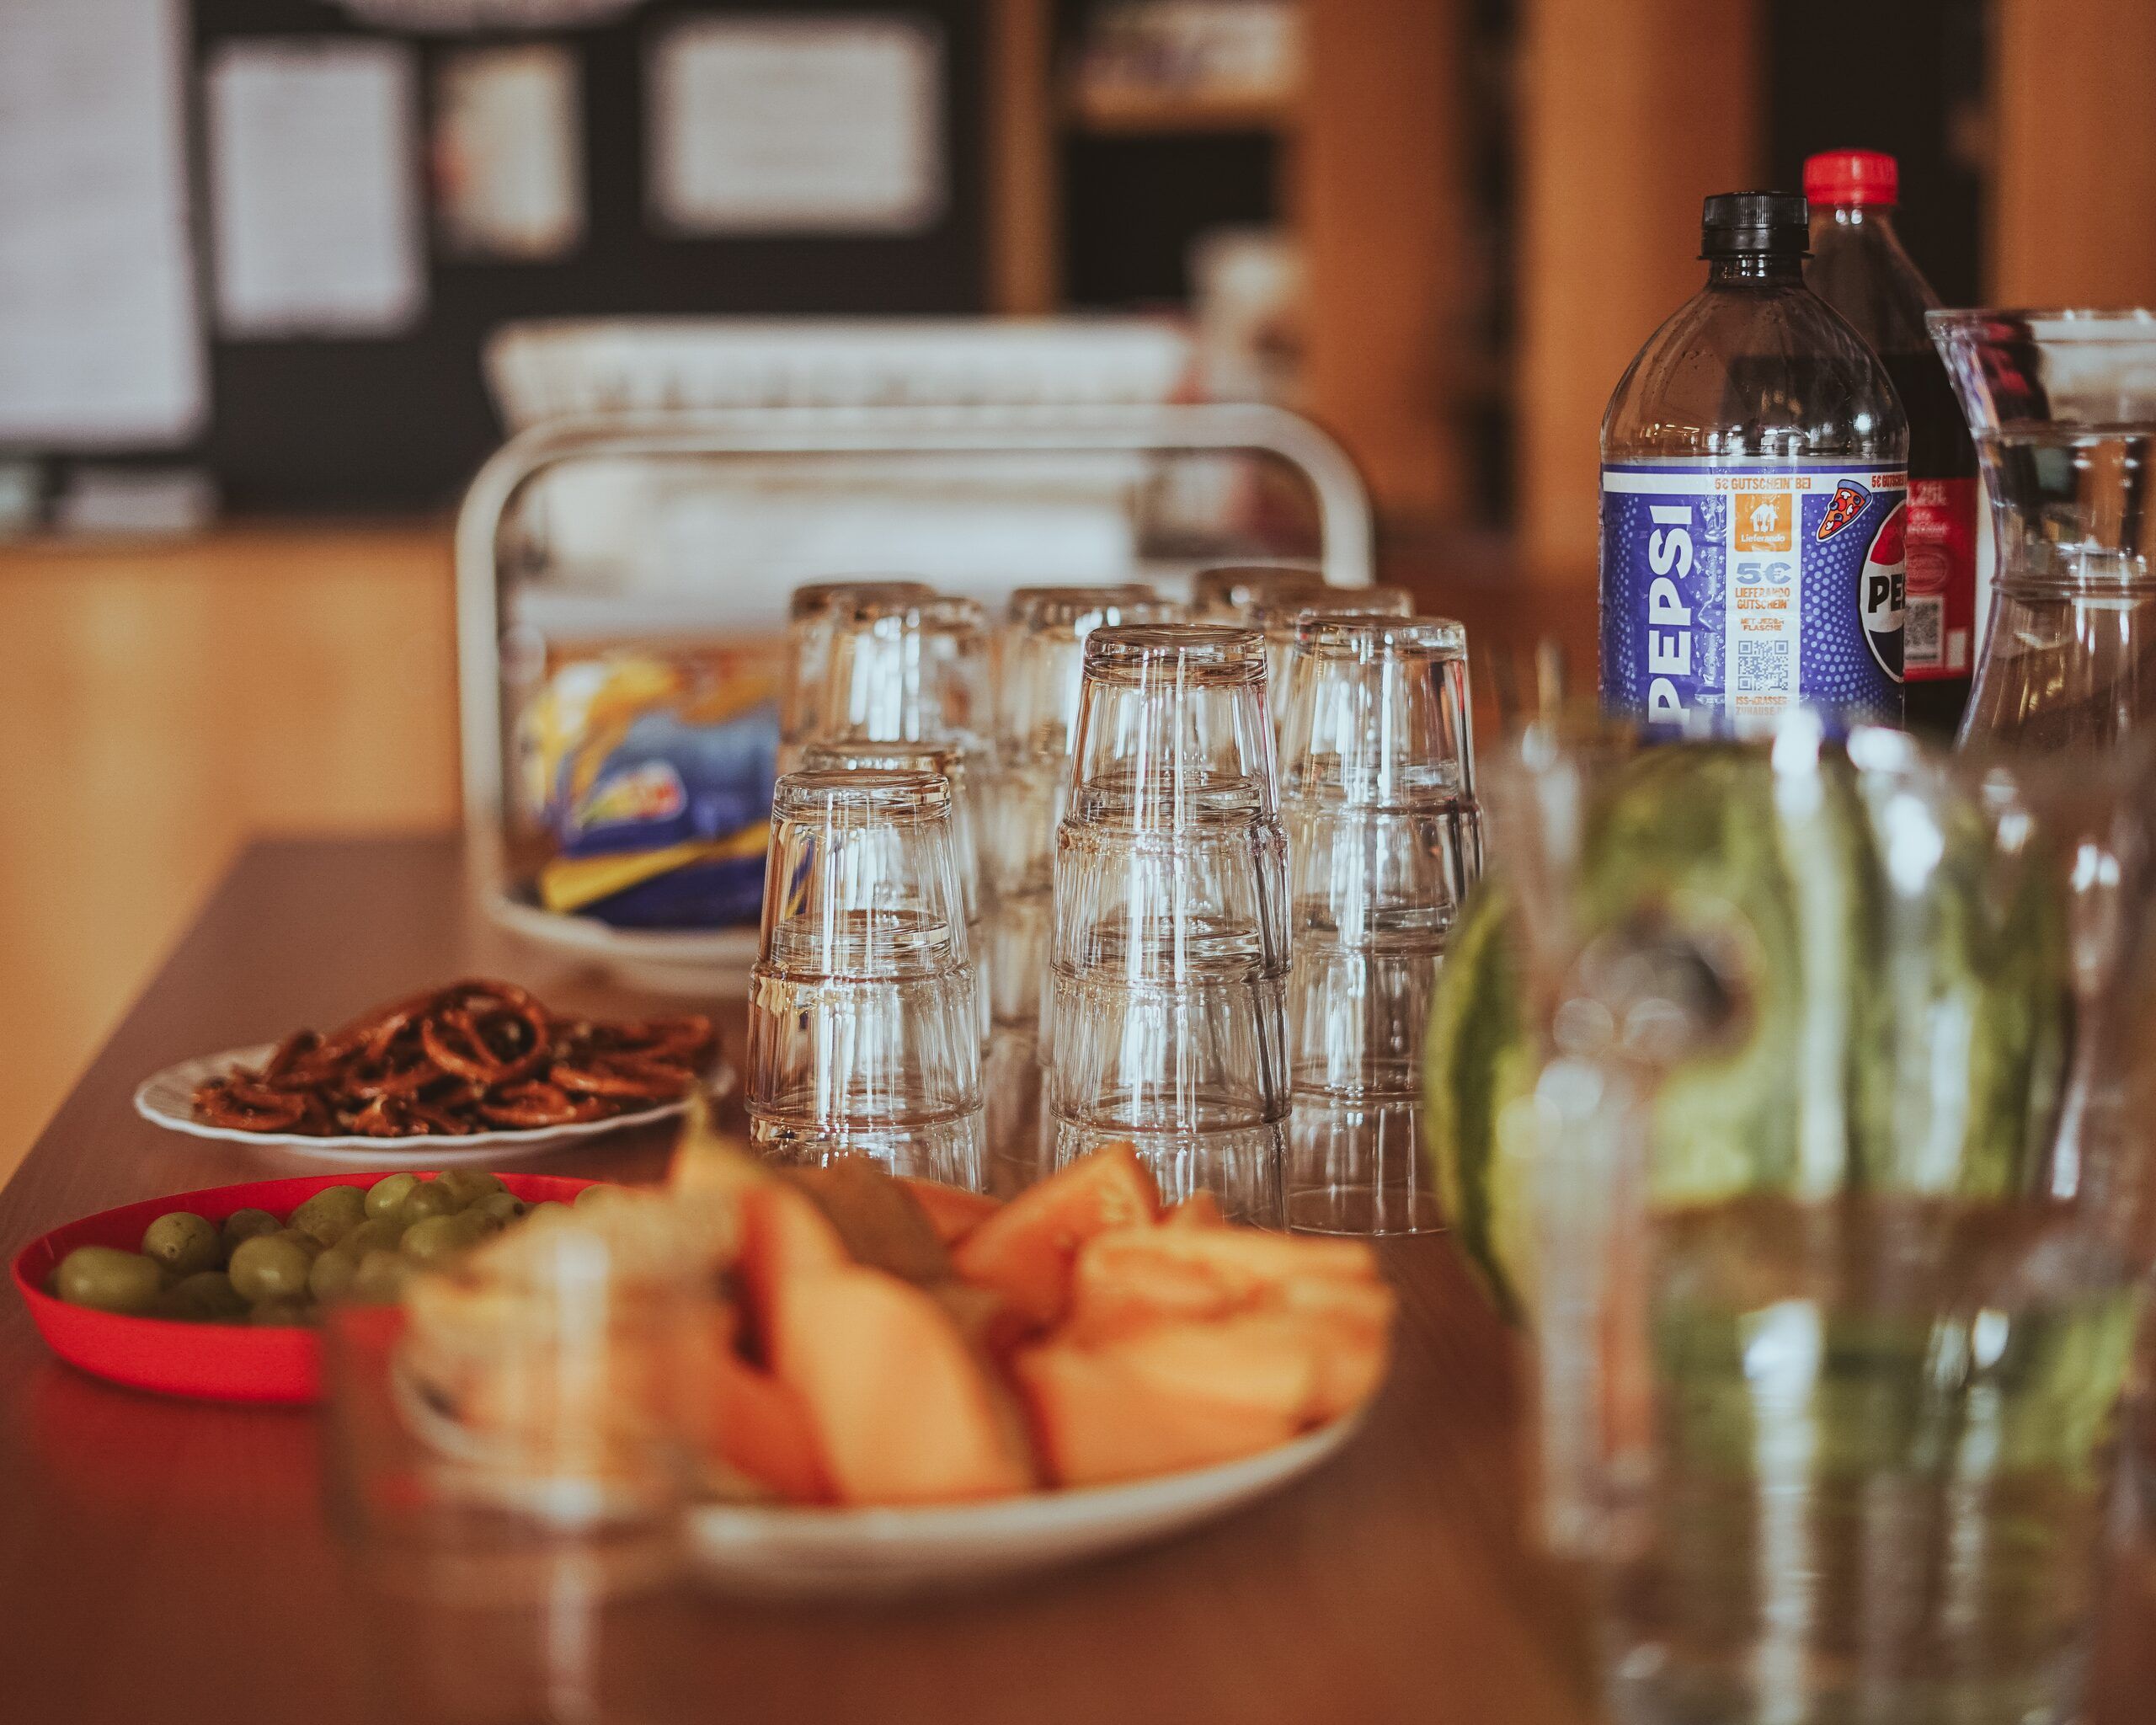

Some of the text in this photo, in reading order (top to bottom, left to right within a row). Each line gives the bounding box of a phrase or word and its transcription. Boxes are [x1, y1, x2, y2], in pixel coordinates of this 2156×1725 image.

[1795, 477, 1812, 489] BEI
[1872, 475, 1881, 489] 5€
[1741, 533, 1785, 542] Lieferando
[1736, 562, 1792, 585] 5€
[1867, 573, 1906, 613] PE
[1648, 505, 1694, 724] PEPSI
